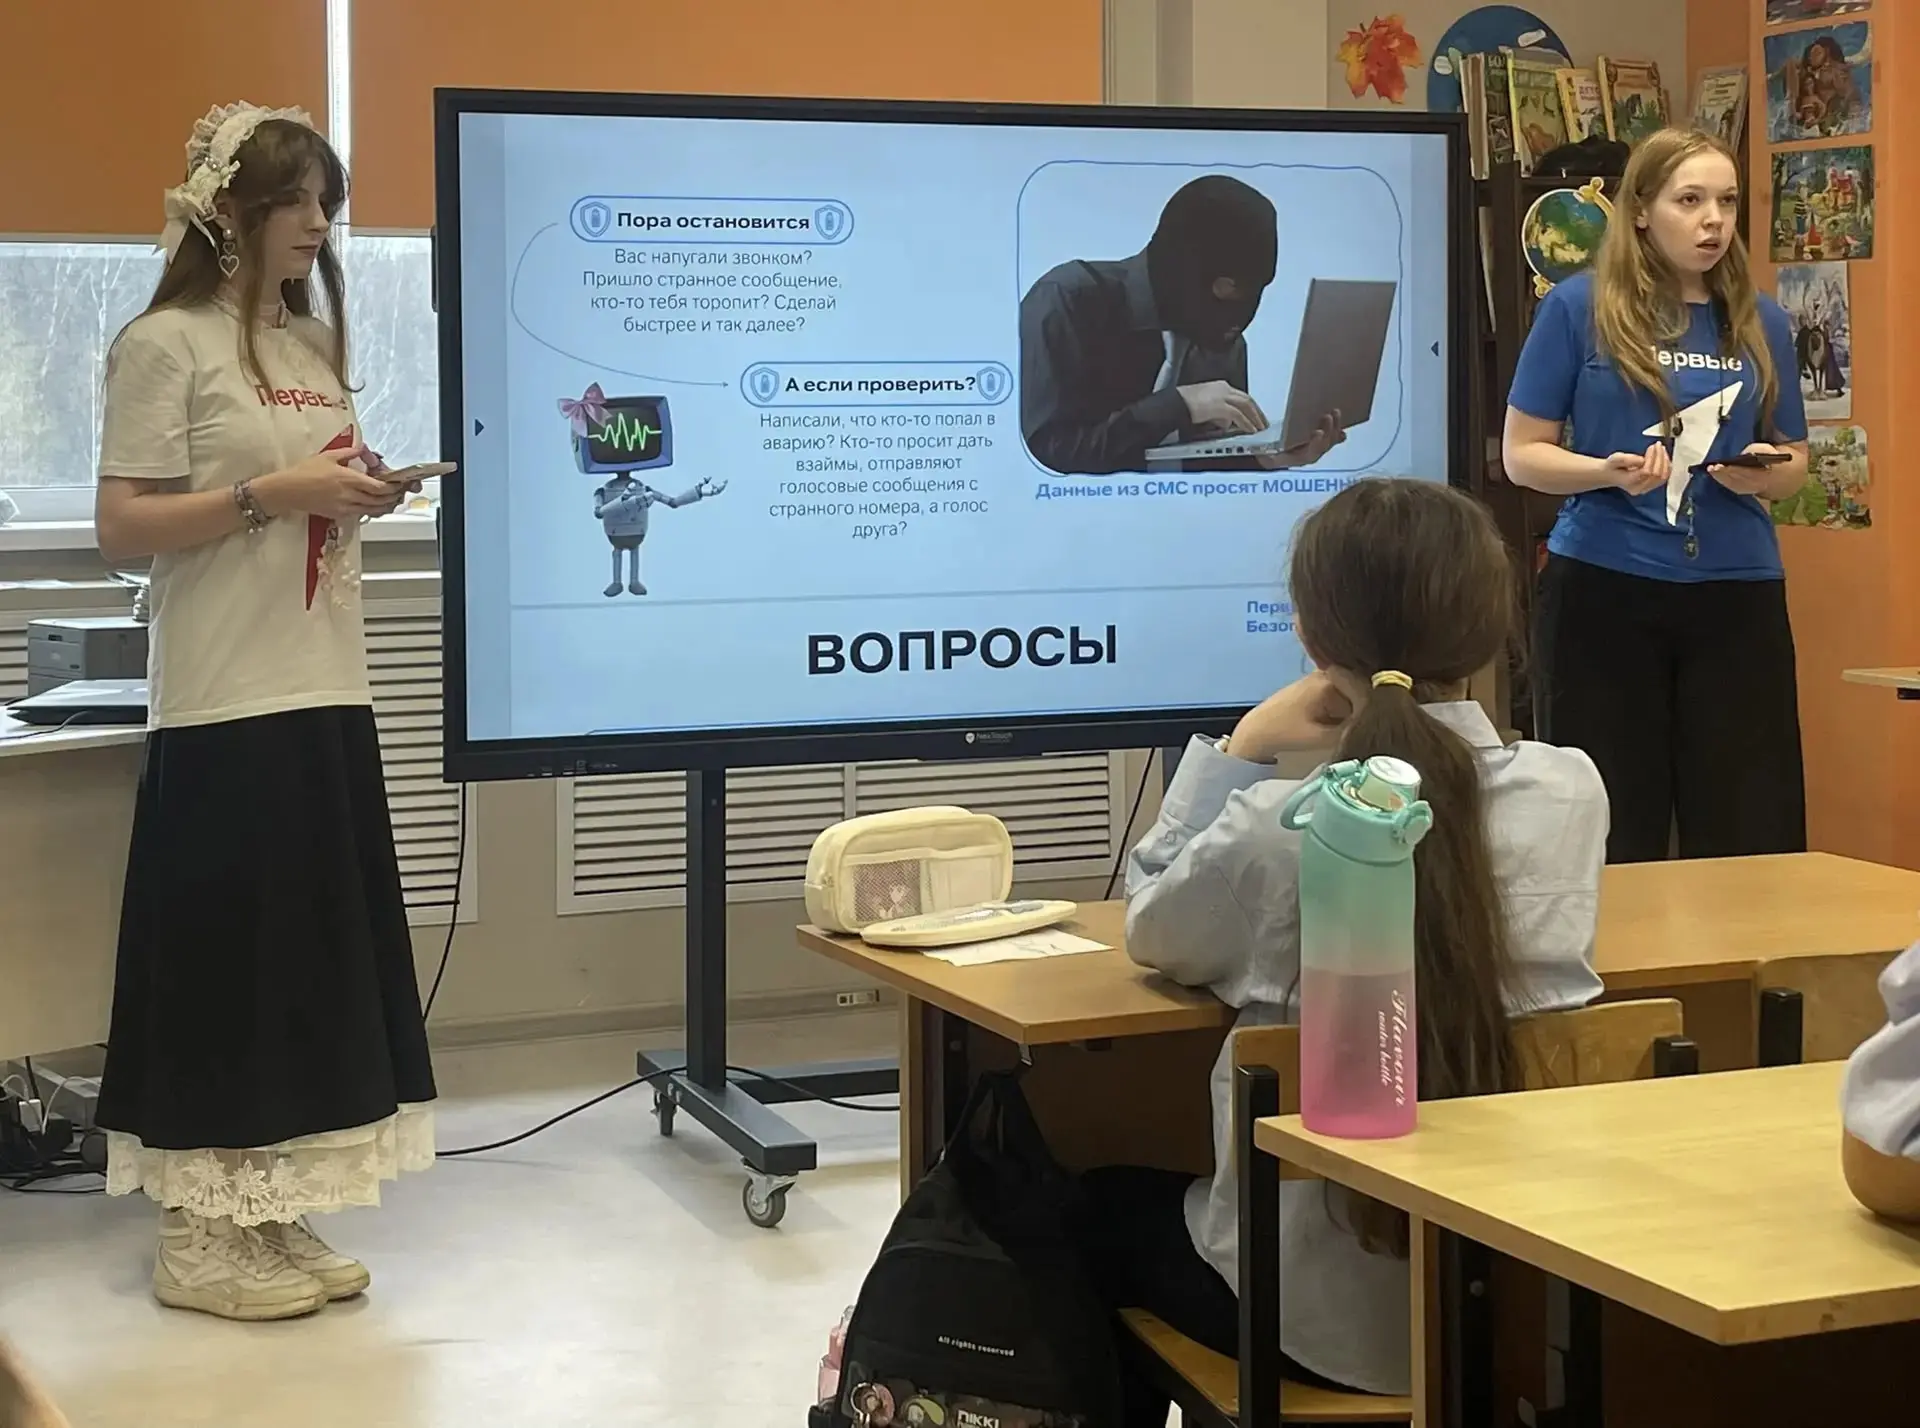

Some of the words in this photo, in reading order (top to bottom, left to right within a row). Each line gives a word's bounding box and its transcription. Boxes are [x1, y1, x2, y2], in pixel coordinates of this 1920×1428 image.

[617, 211, 672, 234] Пора
[675, 214, 810, 230] остановится
[614, 248, 647, 265] Вас
[651, 250, 728, 267] напугали
[732, 249, 813, 266] звонком?
[583, 271, 652, 289] Пришло
[657, 273, 737, 289] странное
[741, 272, 842, 289] сообщение,
[591, 296, 645, 310] кто-то
[649, 294, 688, 310] тебя
[692, 294, 769, 312] торопит?
[774, 294, 837, 312] Сделай
[623, 316, 697, 335] быстрее
[701, 319, 711, 333] и
[716, 319, 742, 333] так
[745, 316, 806, 334] далее?
[785, 377, 800, 393] А
[803, 379, 854, 393] если
[857, 376, 976, 396] проверить?
[760, 413, 845, 429] Написали,
[850, 414, 878, 428] что
[881, 413, 931, 427] кто-то
[935, 413, 983, 427] попал
[987, 414, 997, 426] в
[762, 434, 835, 452] аварию?
[840, 434, 893, 449] Кто-то
[897, 435, 953, 451] просит
[956, 435, 993, 449] дать
[796, 456, 863, 474] взаймы,
[867, 456, 963, 472] отправляют
[779, 478, 868, 495] голосовые
[872, 476, 965, 494] сообщения
[969, 478, 979, 492] с
[1035, 482, 1113, 500] Данные
[1117, 483, 1140, 497] из
[1144, 480, 1189, 496] СМС
[1192, 483, 1259, 498] просят
[769, 502, 854, 519] странного
[858, 500, 925, 517] номера,
[929, 500, 939, 514] а
[943, 499, 989, 514] голос
[851, 521, 908, 540] друга?
[807, 624, 1117, 675] ВОПРОСЫ
[938, 1335, 950, 1345] All
[951, 1339, 976, 1350] rights
[978, 1345, 1014, 1356] reserved
